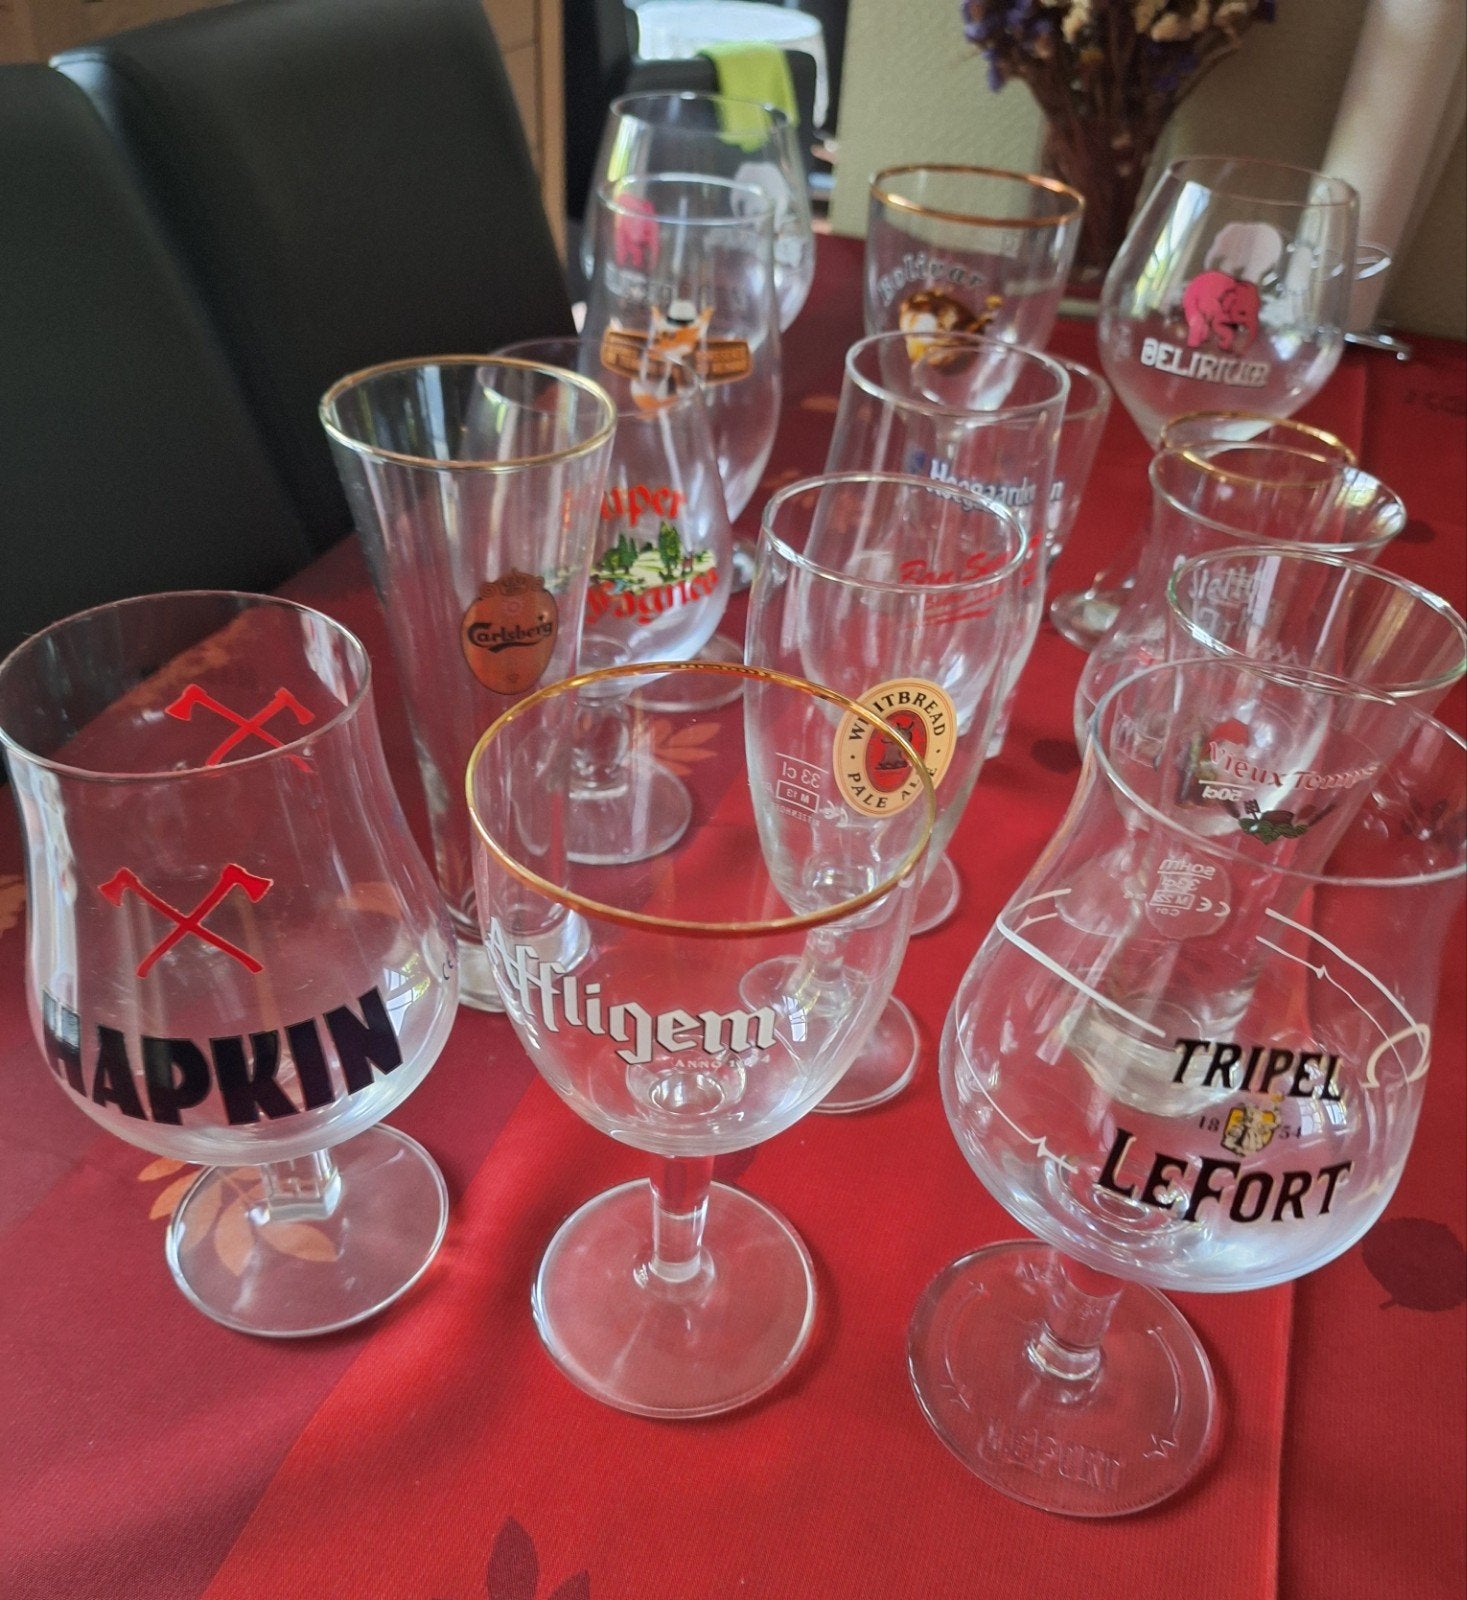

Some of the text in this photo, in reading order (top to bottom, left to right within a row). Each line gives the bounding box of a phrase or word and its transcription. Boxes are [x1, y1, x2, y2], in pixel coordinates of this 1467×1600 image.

[1140, 337, 1271, 388] DELIRIUM
[467, 621, 553, 650] Carlsberg
[1209, 741, 1286, 788] Vieux
[847, 771, 889, 808] PALE
[484, 916, 777, 1065] Affligem
[42, 985, 403, 1126] HAPKIN
[675, 1058, 722, 1069] ANNO
[1172, 1038, 1344, 1101] TRIPEL
[1198, 1114, 1219, 1132] 18
